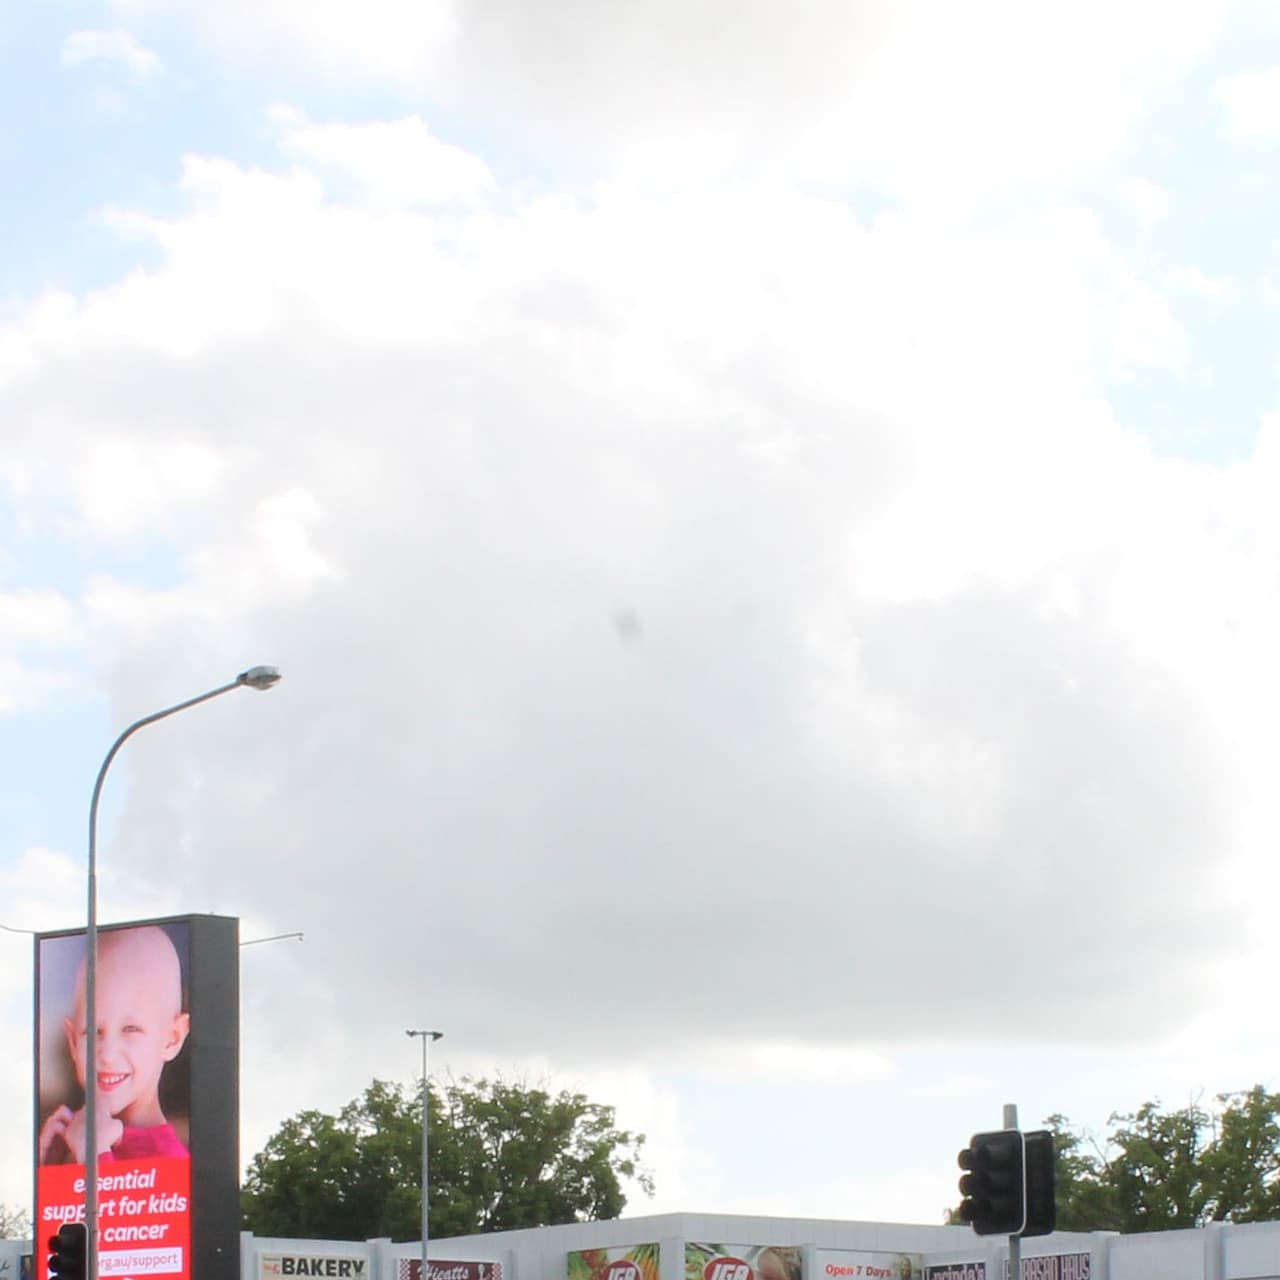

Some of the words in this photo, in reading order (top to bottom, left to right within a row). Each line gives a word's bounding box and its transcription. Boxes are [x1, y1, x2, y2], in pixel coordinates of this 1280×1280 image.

[74, 1168, 156, 1193] esential
[43, 1200, 116, 1222] supprt
[119, 1196, 147, 1216] for
[148, 1193, 187, 1214] kids
[104, 1224, 169, 1242] cancer
[98, 1253, 178, 1270] rg.au/support
[282, 1257, 365, 1277] BAKERY
[825, 1264, 853, 1278] Open
[856, 1265, 863, 1276] 7
[865, 1266, 892, 1279] Days
